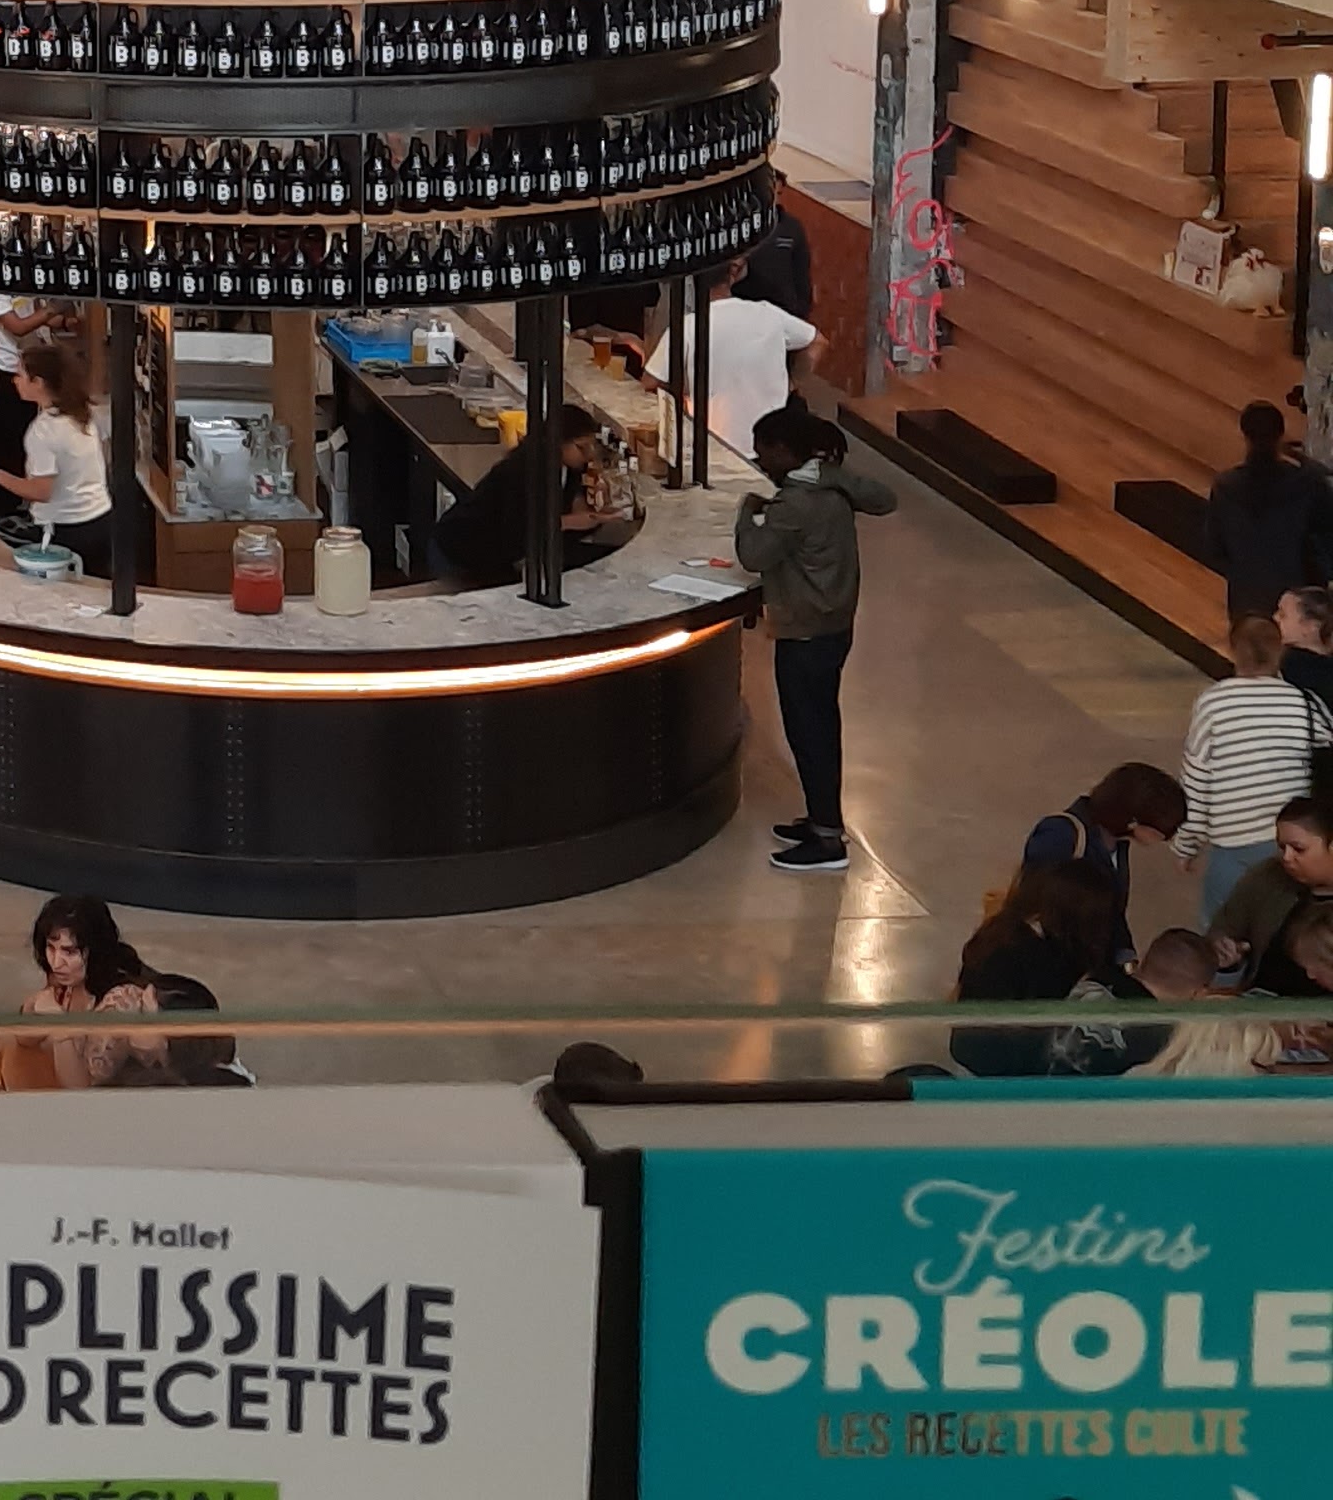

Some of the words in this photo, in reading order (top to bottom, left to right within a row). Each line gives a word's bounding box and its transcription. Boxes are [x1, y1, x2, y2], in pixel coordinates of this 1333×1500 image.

[51, 1218, 121, 1249] J.-F.
[132, 1220, 233, 1252] Mallet
[902, 1178, 1211, 1296] Festins
[704, 1276, 1333, 1395] CRÉOLE
[46, 1357, 452, 1445] RECETTES
[816, 1412, 892, 1458] LES
[904, 1410, 1113, 1457] RECETTES
